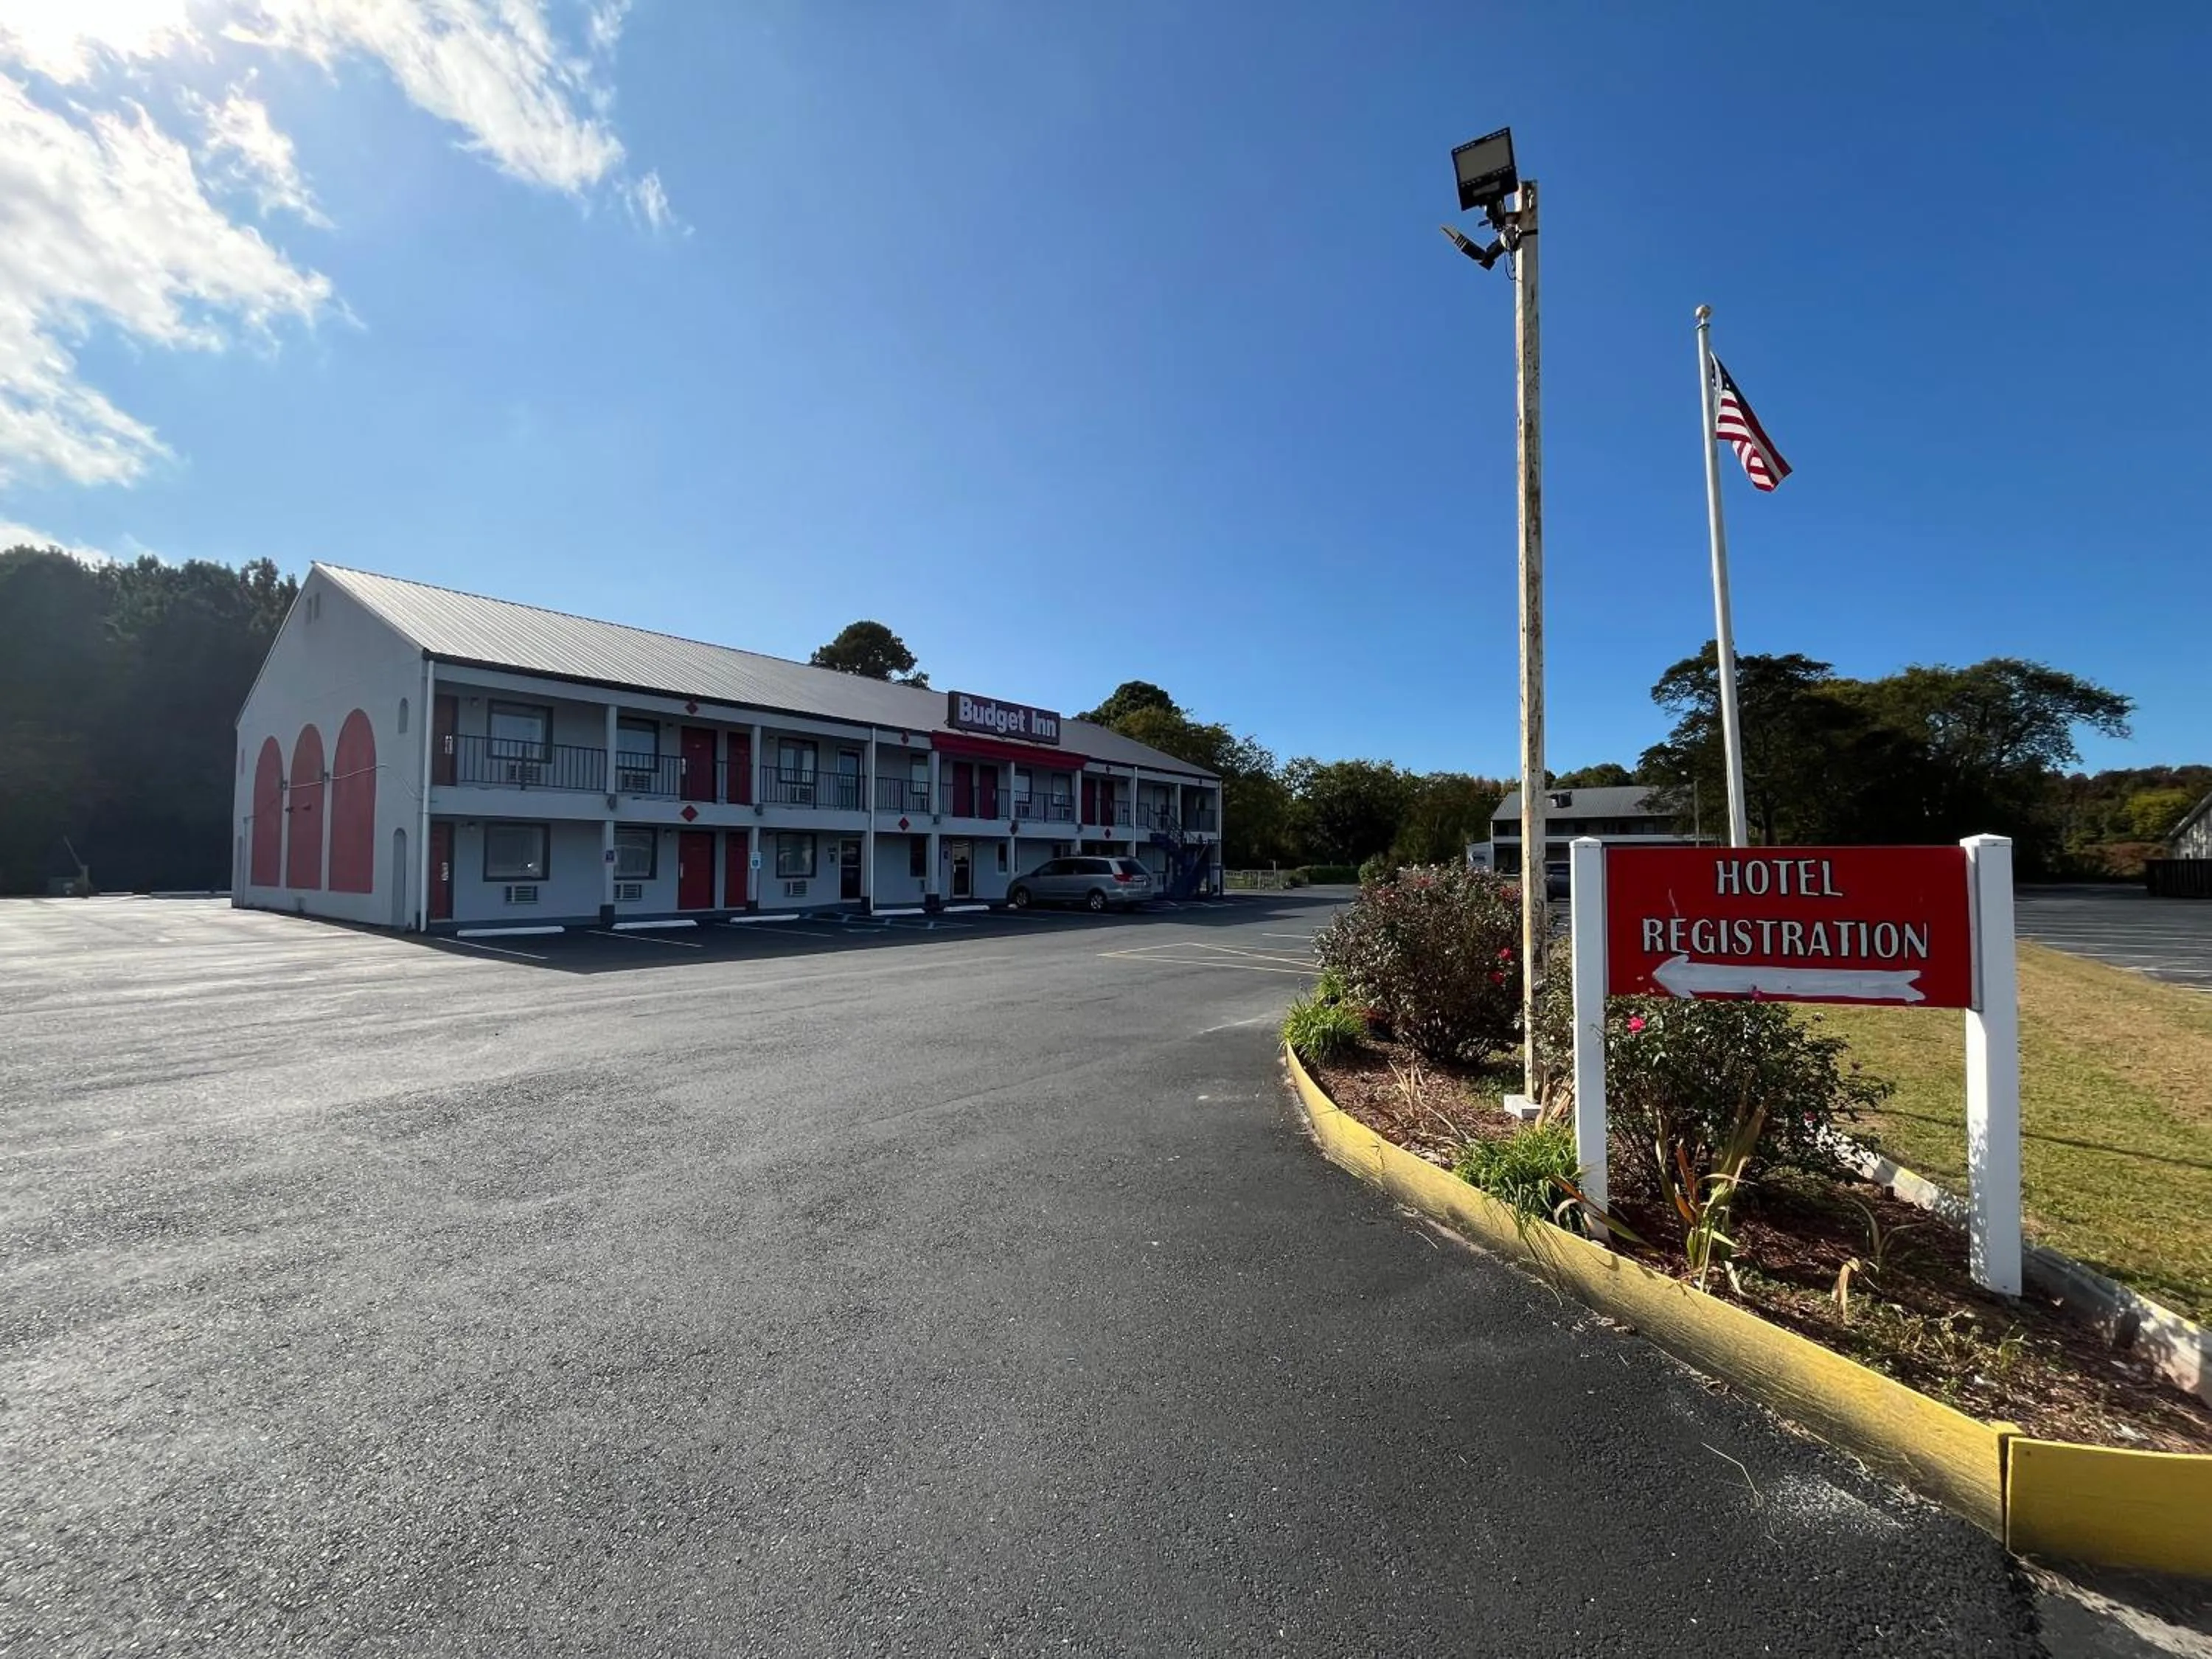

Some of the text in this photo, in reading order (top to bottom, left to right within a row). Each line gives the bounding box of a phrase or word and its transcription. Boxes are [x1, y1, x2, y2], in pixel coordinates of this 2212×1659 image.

[959, 695, 1057, 737] Budget Inn
[1715, 860, 1843, 897] HOTEL
[1642, 918, 1929, 959] REGISTRATION
